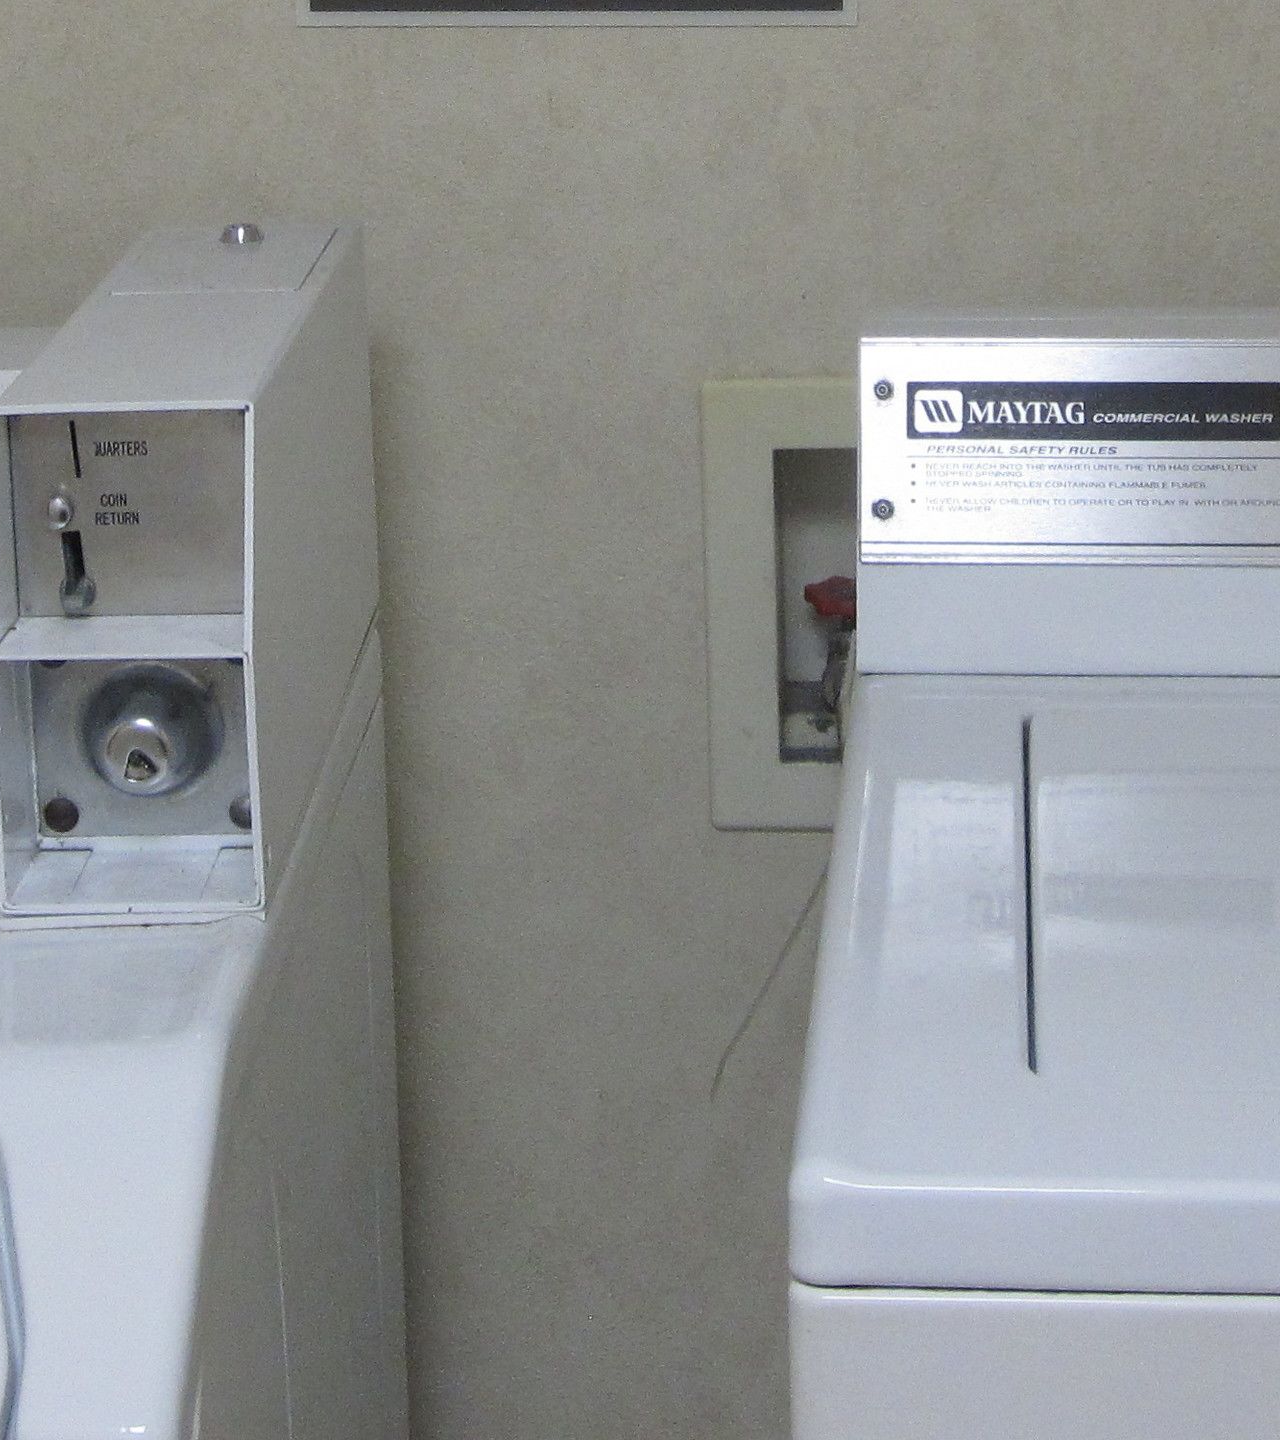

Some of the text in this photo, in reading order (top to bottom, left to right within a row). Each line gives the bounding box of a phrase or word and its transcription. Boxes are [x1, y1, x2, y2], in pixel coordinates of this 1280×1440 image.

[967, 401, 1275, 425] MAYTAG COMMERCIAL WASHER
[925, 444, 1119, 456] PERSONAL SAFETY RULES
[100, 493, 127, 508] COIN
[95, 511, 140, 526] RETURN
